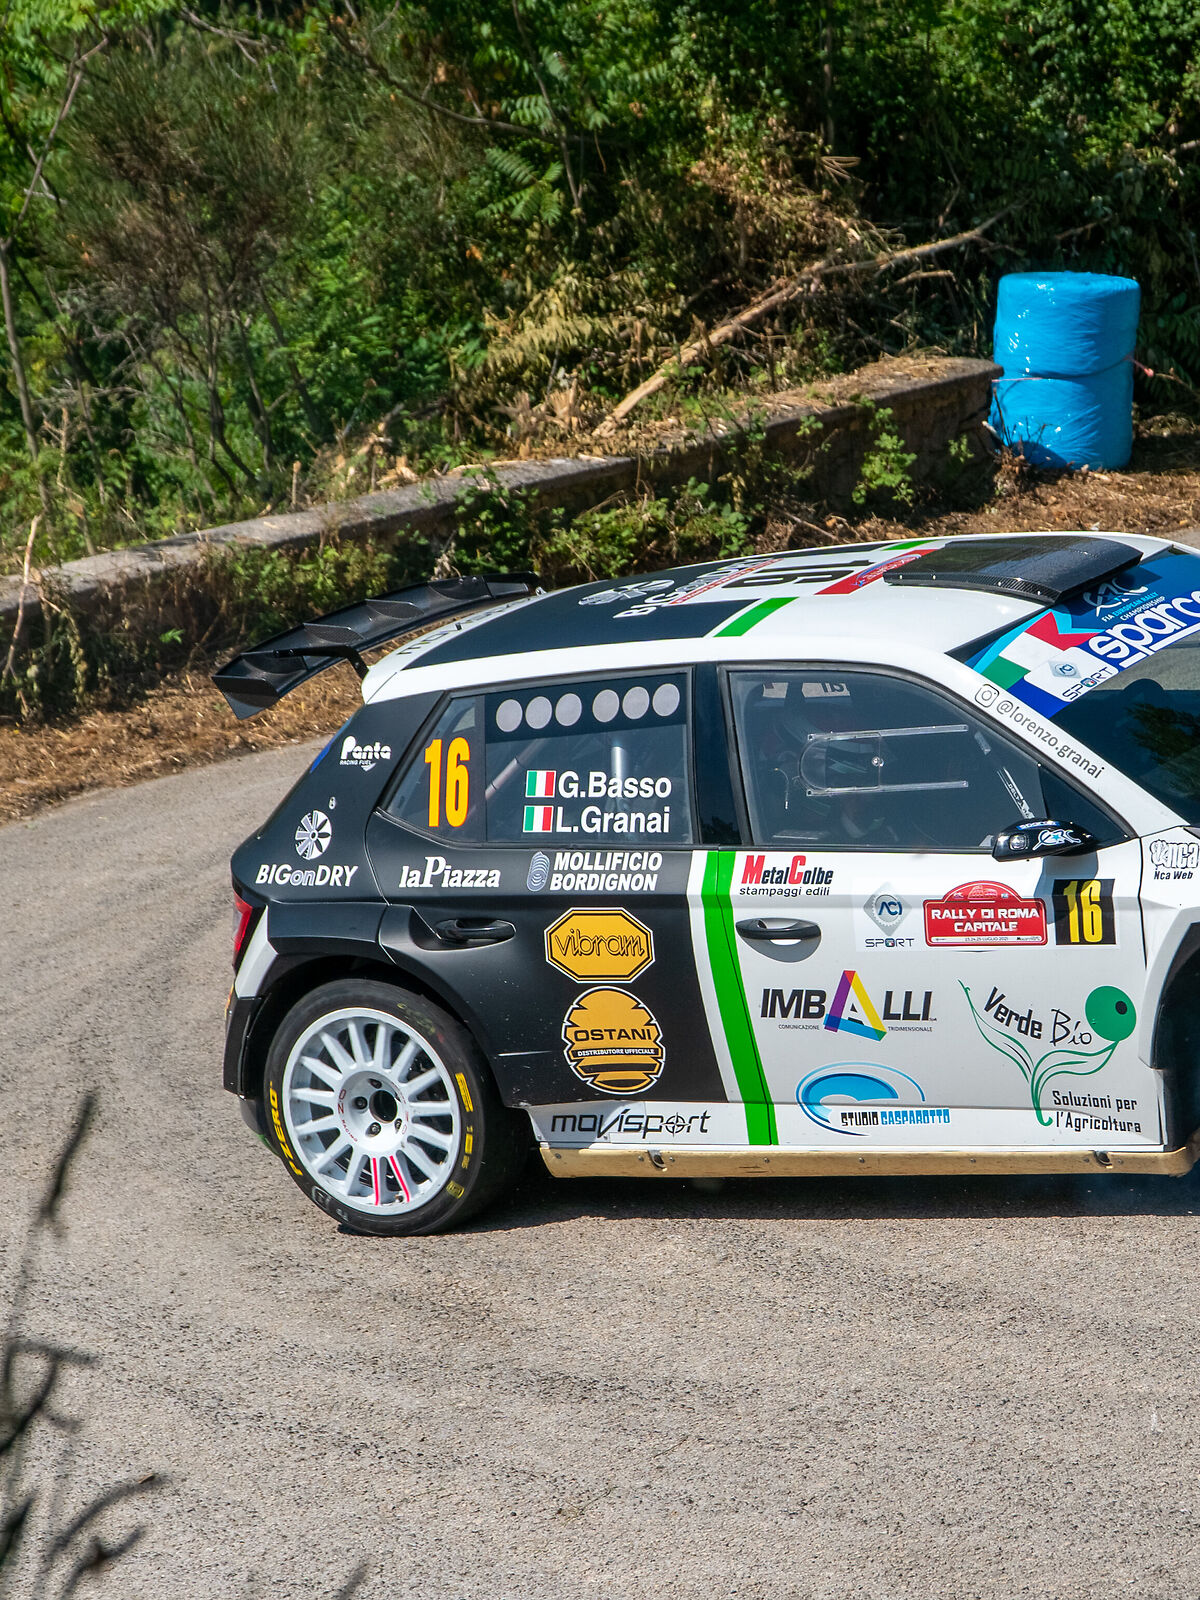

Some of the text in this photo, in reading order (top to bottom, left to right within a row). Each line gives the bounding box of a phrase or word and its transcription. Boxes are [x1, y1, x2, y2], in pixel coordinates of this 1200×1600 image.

[1101, 613, 1115, 622] FIA
[1112, 599, 1142, 617] EUROPEAN
[1120, 596, 1165, 621] CHAMPIONSHIP
[341, 735, 392, 760] Panta
[996, 700, 1105, 779] @lorenzo.granai
[424, 737, 471, 828] 16
[557, 771, 673, 799] G.Basso
[556, 804, 670, 834] L.Granai
[399, 856, 501, 888] laPiazza
[553, 851, 663, 872] MOLLIFICIO
[741, 855, 834, 885] MetalColbe
[255, 863, 358, 887] BIGonDRY
[549, 873, 658, 891] BORDIGNON
[1154, 870, 1194, 880] Nca Web
[739, 886, 830, 898] stampaggi edili
[877, 901, 903, 916] ACI
[931, 908, 1040, 919] RALLY DI ROMA
[1063, 880, 1102, 944] 16
[954, 922, 1018, 932] CAPITALE
[554, 928, 645, 957] vibram
[865, 937, 915, 948] SPORT
[984, 987, 1093, 1047] Verde Bio
[574, 1028, 652, 1042] OSTANI
[577, 1049, 624, 1057] DISTRIBUTORE
[1052, 1090, 1138, 1113] Soluzioni per
[551, 1108, 711, 1139] movisport
[841, 1108, 950, 1127] STUDIO GASPAROTTO
[1055, 1110, 1142, 1134] l'Agricoltura
